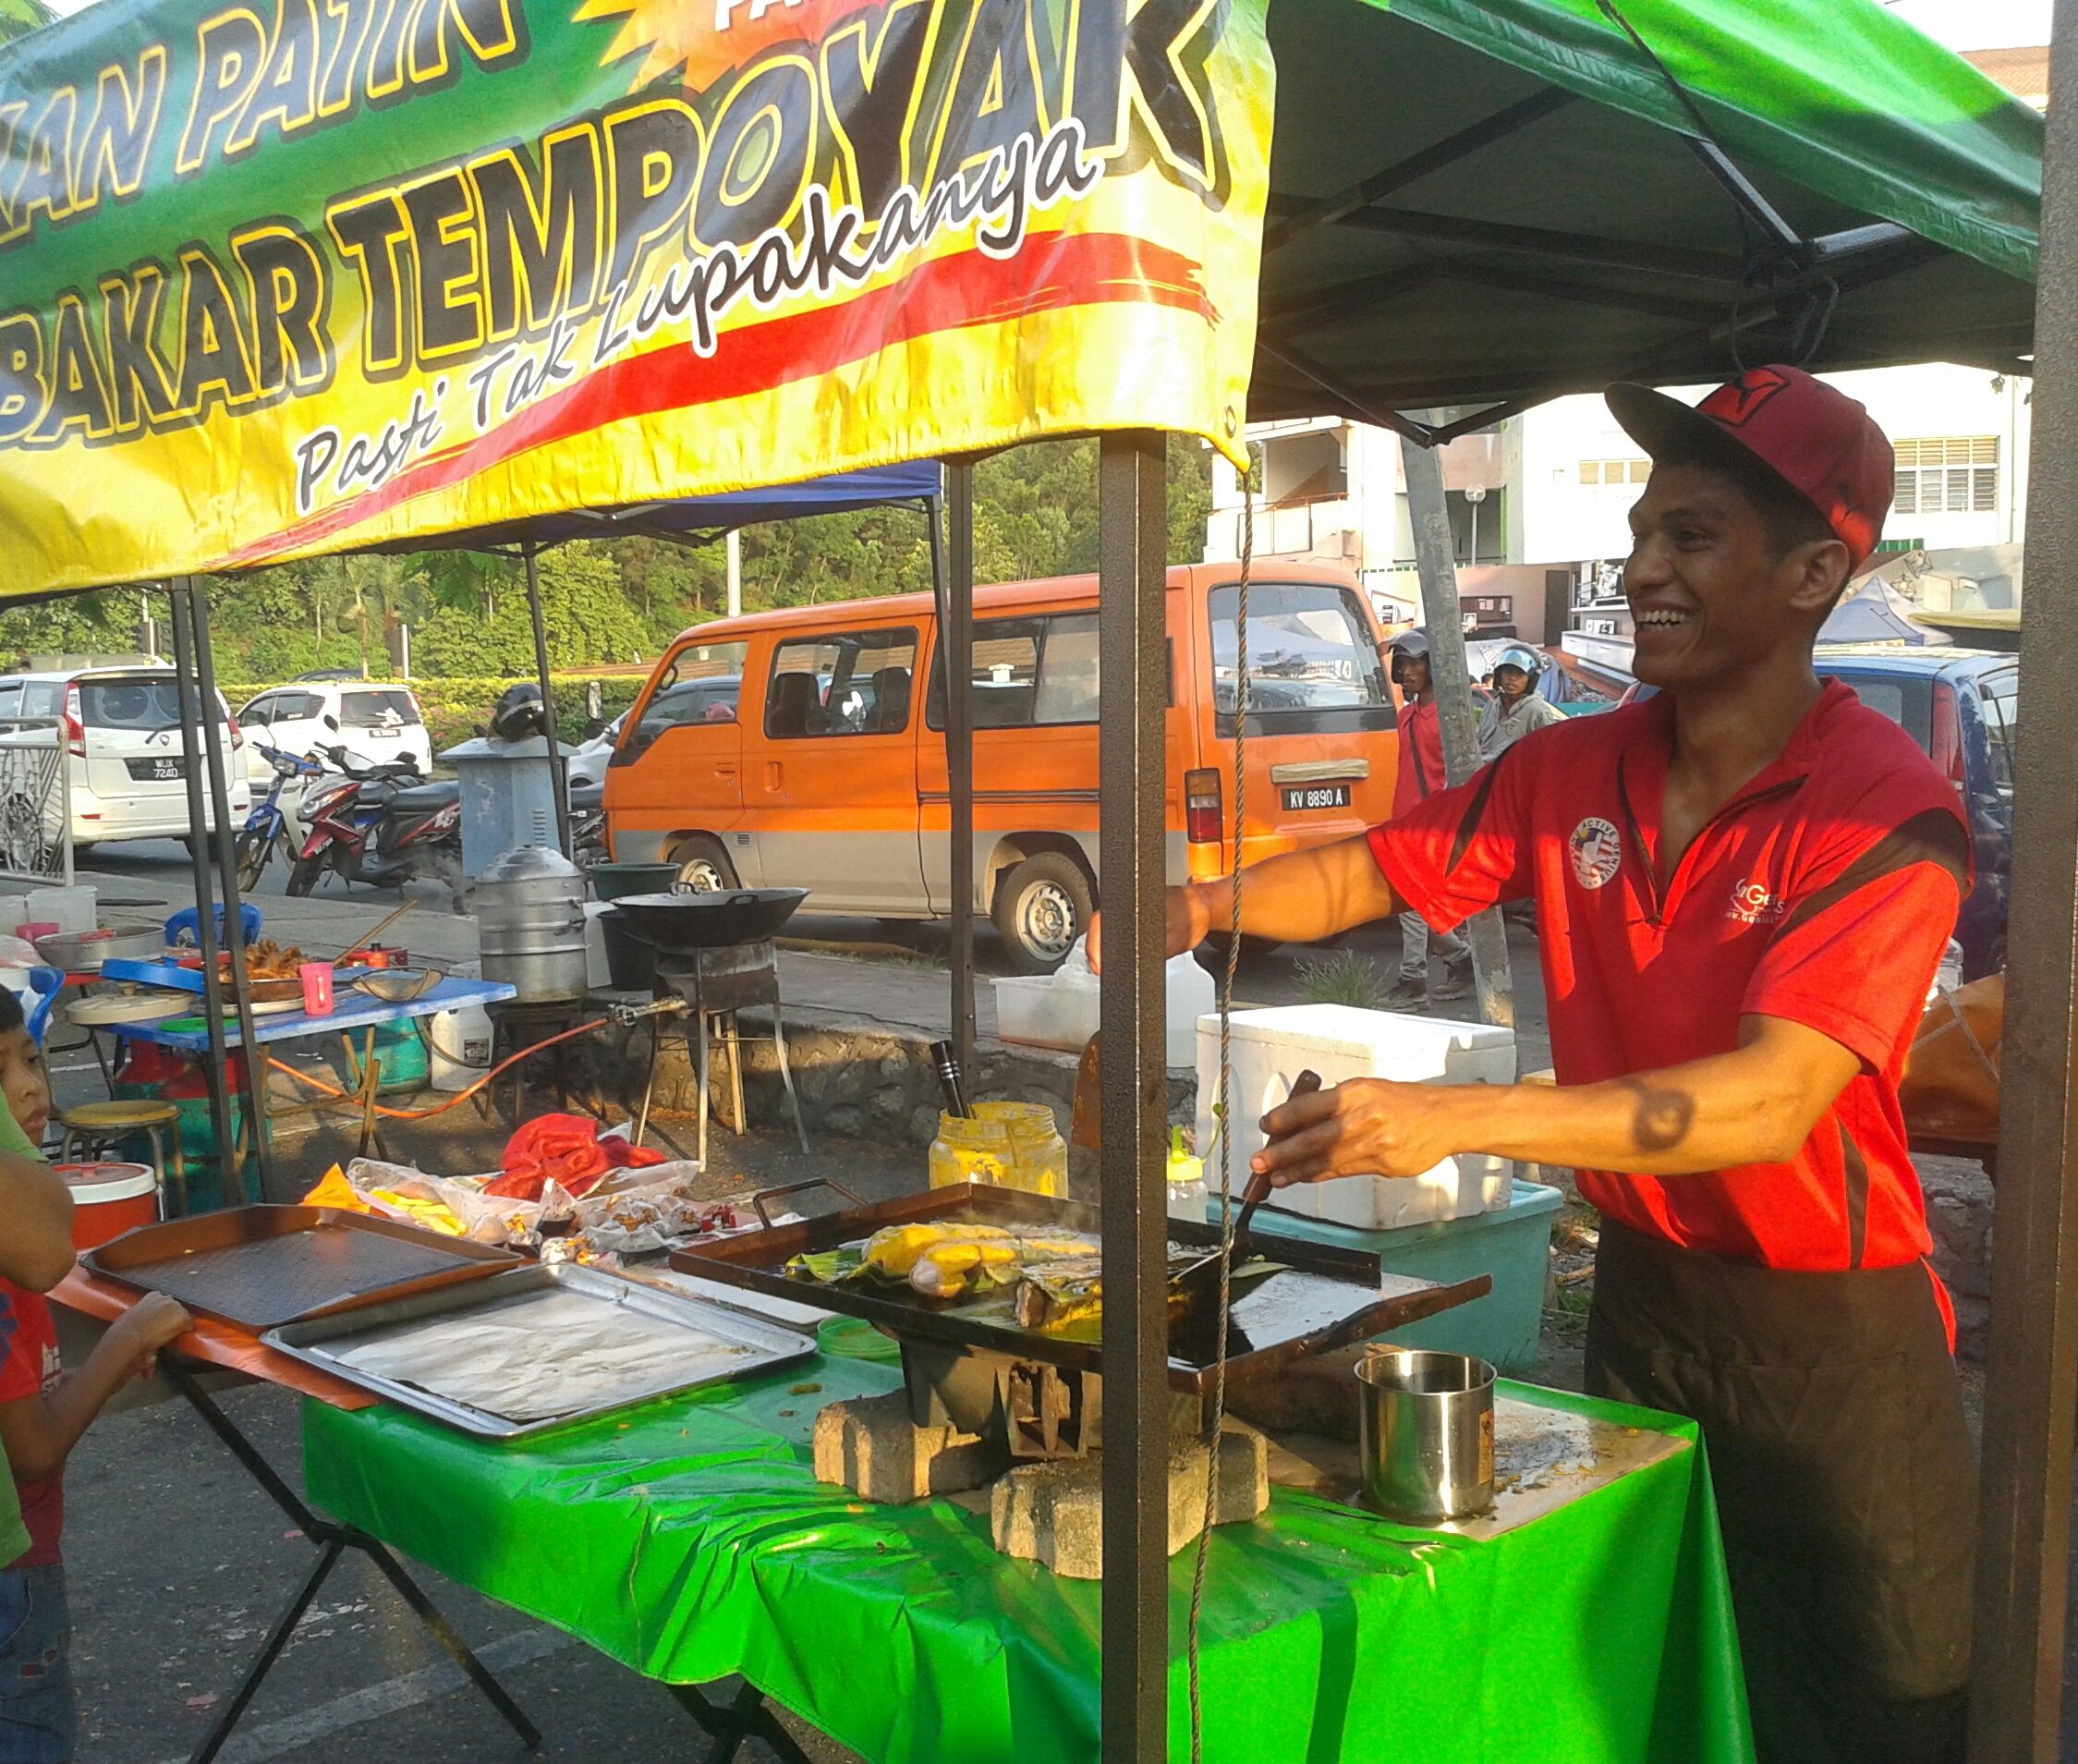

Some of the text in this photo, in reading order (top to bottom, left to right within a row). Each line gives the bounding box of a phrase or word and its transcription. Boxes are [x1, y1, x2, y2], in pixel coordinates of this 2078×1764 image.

[0, 0, 1220, 442] BAKAR TEMPOYAK
[296, 122, 1100, 513] Pasti Tak Lupakanya
[153, 768, 178, 778] 7240
[1290, 787, 1343, 809] KV 8890 A
[1582, 820, 1621, 882] ACTIVE GENIUS
